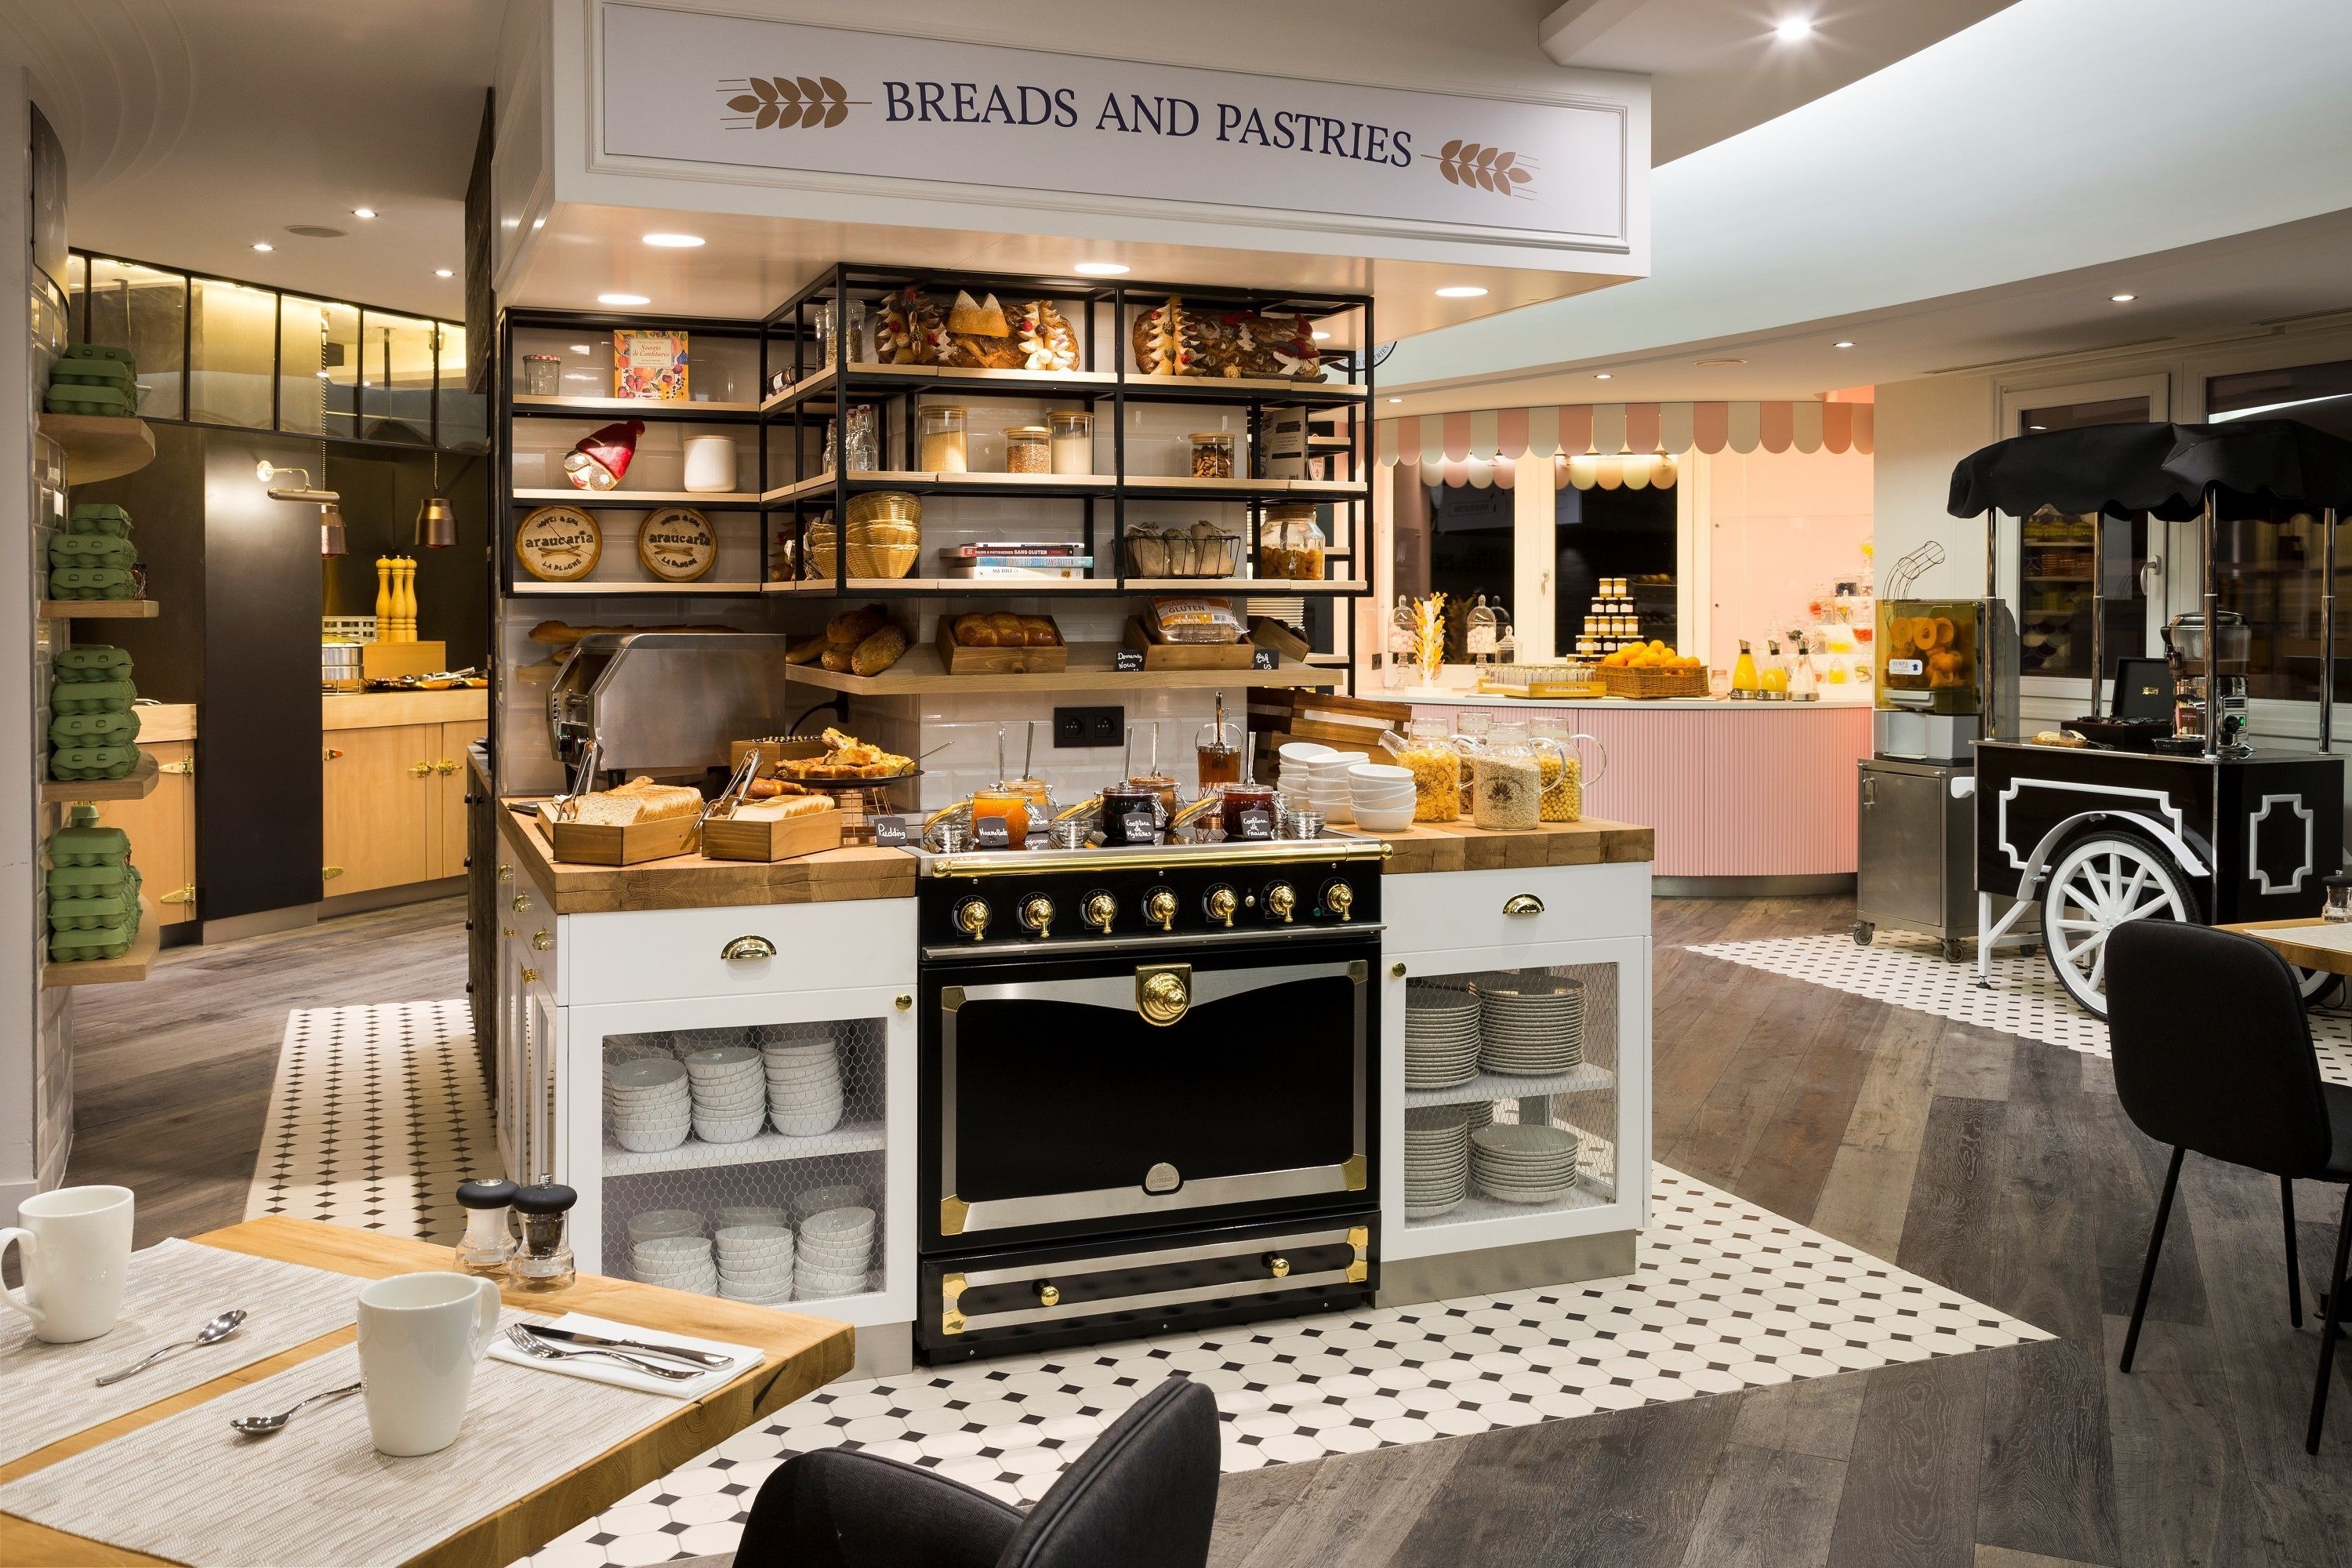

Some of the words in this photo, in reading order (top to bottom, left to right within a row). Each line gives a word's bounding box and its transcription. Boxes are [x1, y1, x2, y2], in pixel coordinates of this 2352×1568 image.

[883, 82, 1078, 128] BREADS
[1095, 92, 1200, 136] AND
[1216, 103, 1412, 168] PASTRIES
[525, 530, 594, 548] araucaria
[648, 532, 711, 546] araucaria
[542, 561, 552, 569] LA
[554, 558, 582, 572] PLAGNE
[878, 823, 906, 839] Pudding
